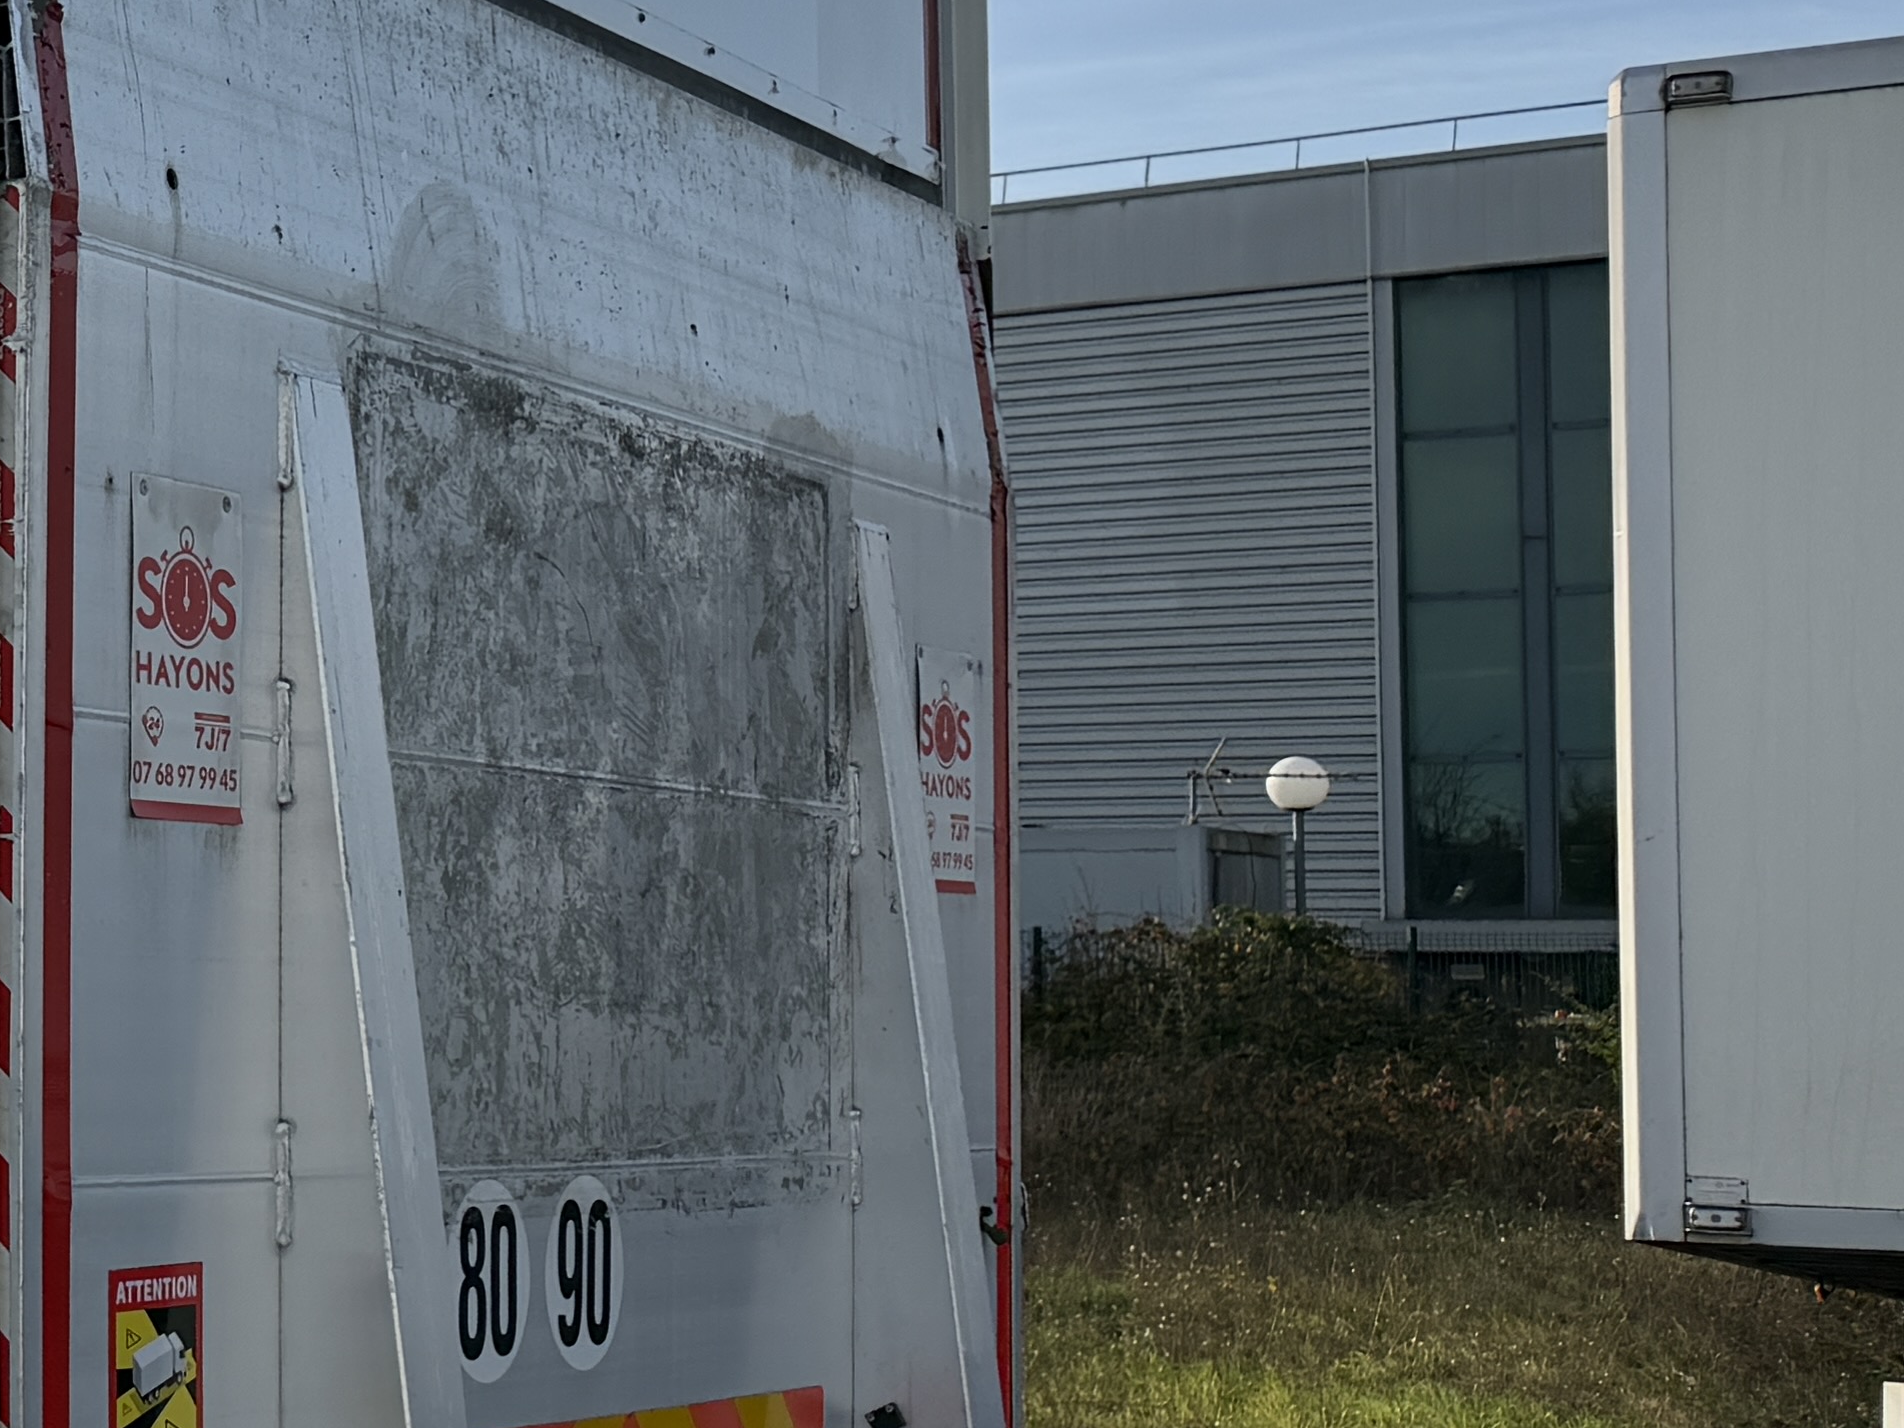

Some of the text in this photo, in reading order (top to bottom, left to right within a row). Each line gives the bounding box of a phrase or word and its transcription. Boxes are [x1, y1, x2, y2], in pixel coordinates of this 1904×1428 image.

[136, 551, 237, 649] SOS
[135, 650, 235, 695] HAYONS
[921, 699, 972, 769] SOS
[133, 760, 238, 792] 07 68 97 99 45
[922, 772, 972, 801] HAYONS
[115, 1274, 197, 1305] ATTENTION
[458, 1204, 517, 1361] 80
[557, 1199, 612, 1347] 90
